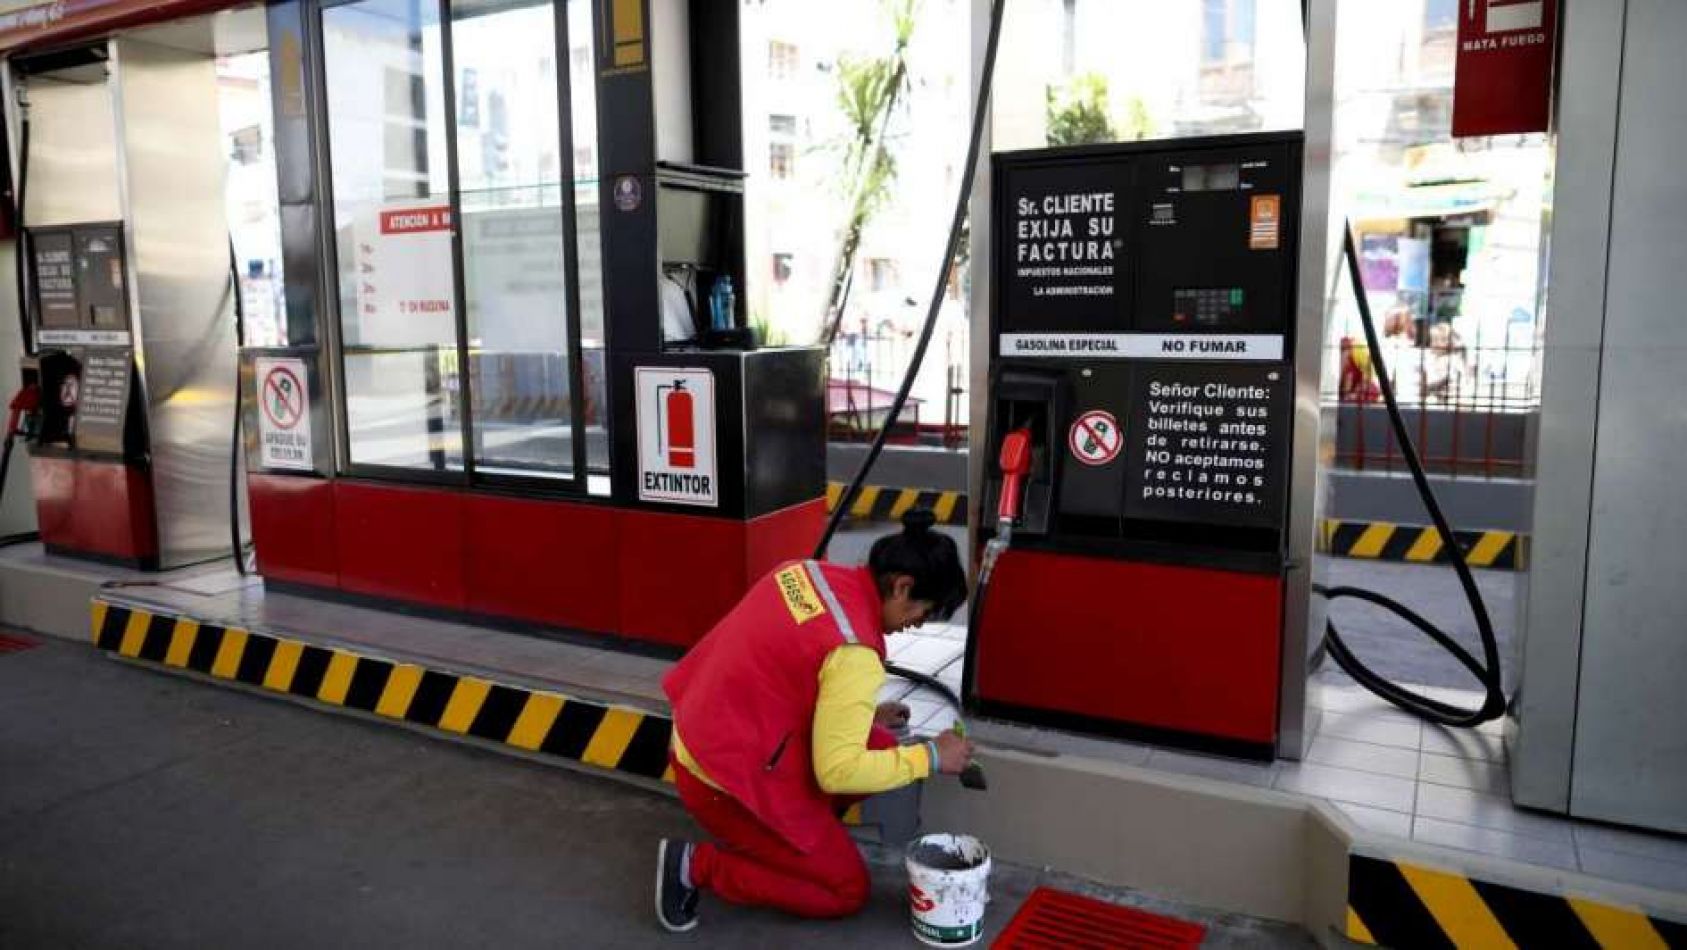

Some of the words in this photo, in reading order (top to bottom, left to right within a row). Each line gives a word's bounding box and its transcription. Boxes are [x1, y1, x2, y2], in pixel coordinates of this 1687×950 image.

[1501, 33, 1545, 46] FUEGO
[1018, 197, 1039, 216] Sr.
[1043, 192, 1115, 214] CLIENTE
[1018, 219, 1074, 239] EXIJA
[1088, 216, 1115, 236] SU
[1017, 240, 1115, 262] FACTURA
[1063, 265, 1114, 275] NACIONALES
[1016, 338, 1066, 351] GASOLINA
[1068, 338, 1118, 351] ESPECIAL
[1162, 339, 1184, 353] NO
[1190, 340, 1247, 353] FUMAR
[1150, 382, 1200, 397] Señor
[1204, 383, 1270, 399] Cliente:
[1149, 400, 1224, 417] Verifique
[1236, 406, 1268, 417] sus
[1148, 417, 1208, 431] billetes
[1219, 421, 1267, 436] antes
[1147, 434, 1167, 446] de
[1181, 436, 1266, 452] retirarse.
[1146, 451, 1170, 463] NO
[1174, 454, 1264, 469] aceptamos
[644, 471, 711, 495] EXTINTOR
[1144, 469, 1263, 486] reclamos
[1143, 486, 1262, 504] posteriores.
